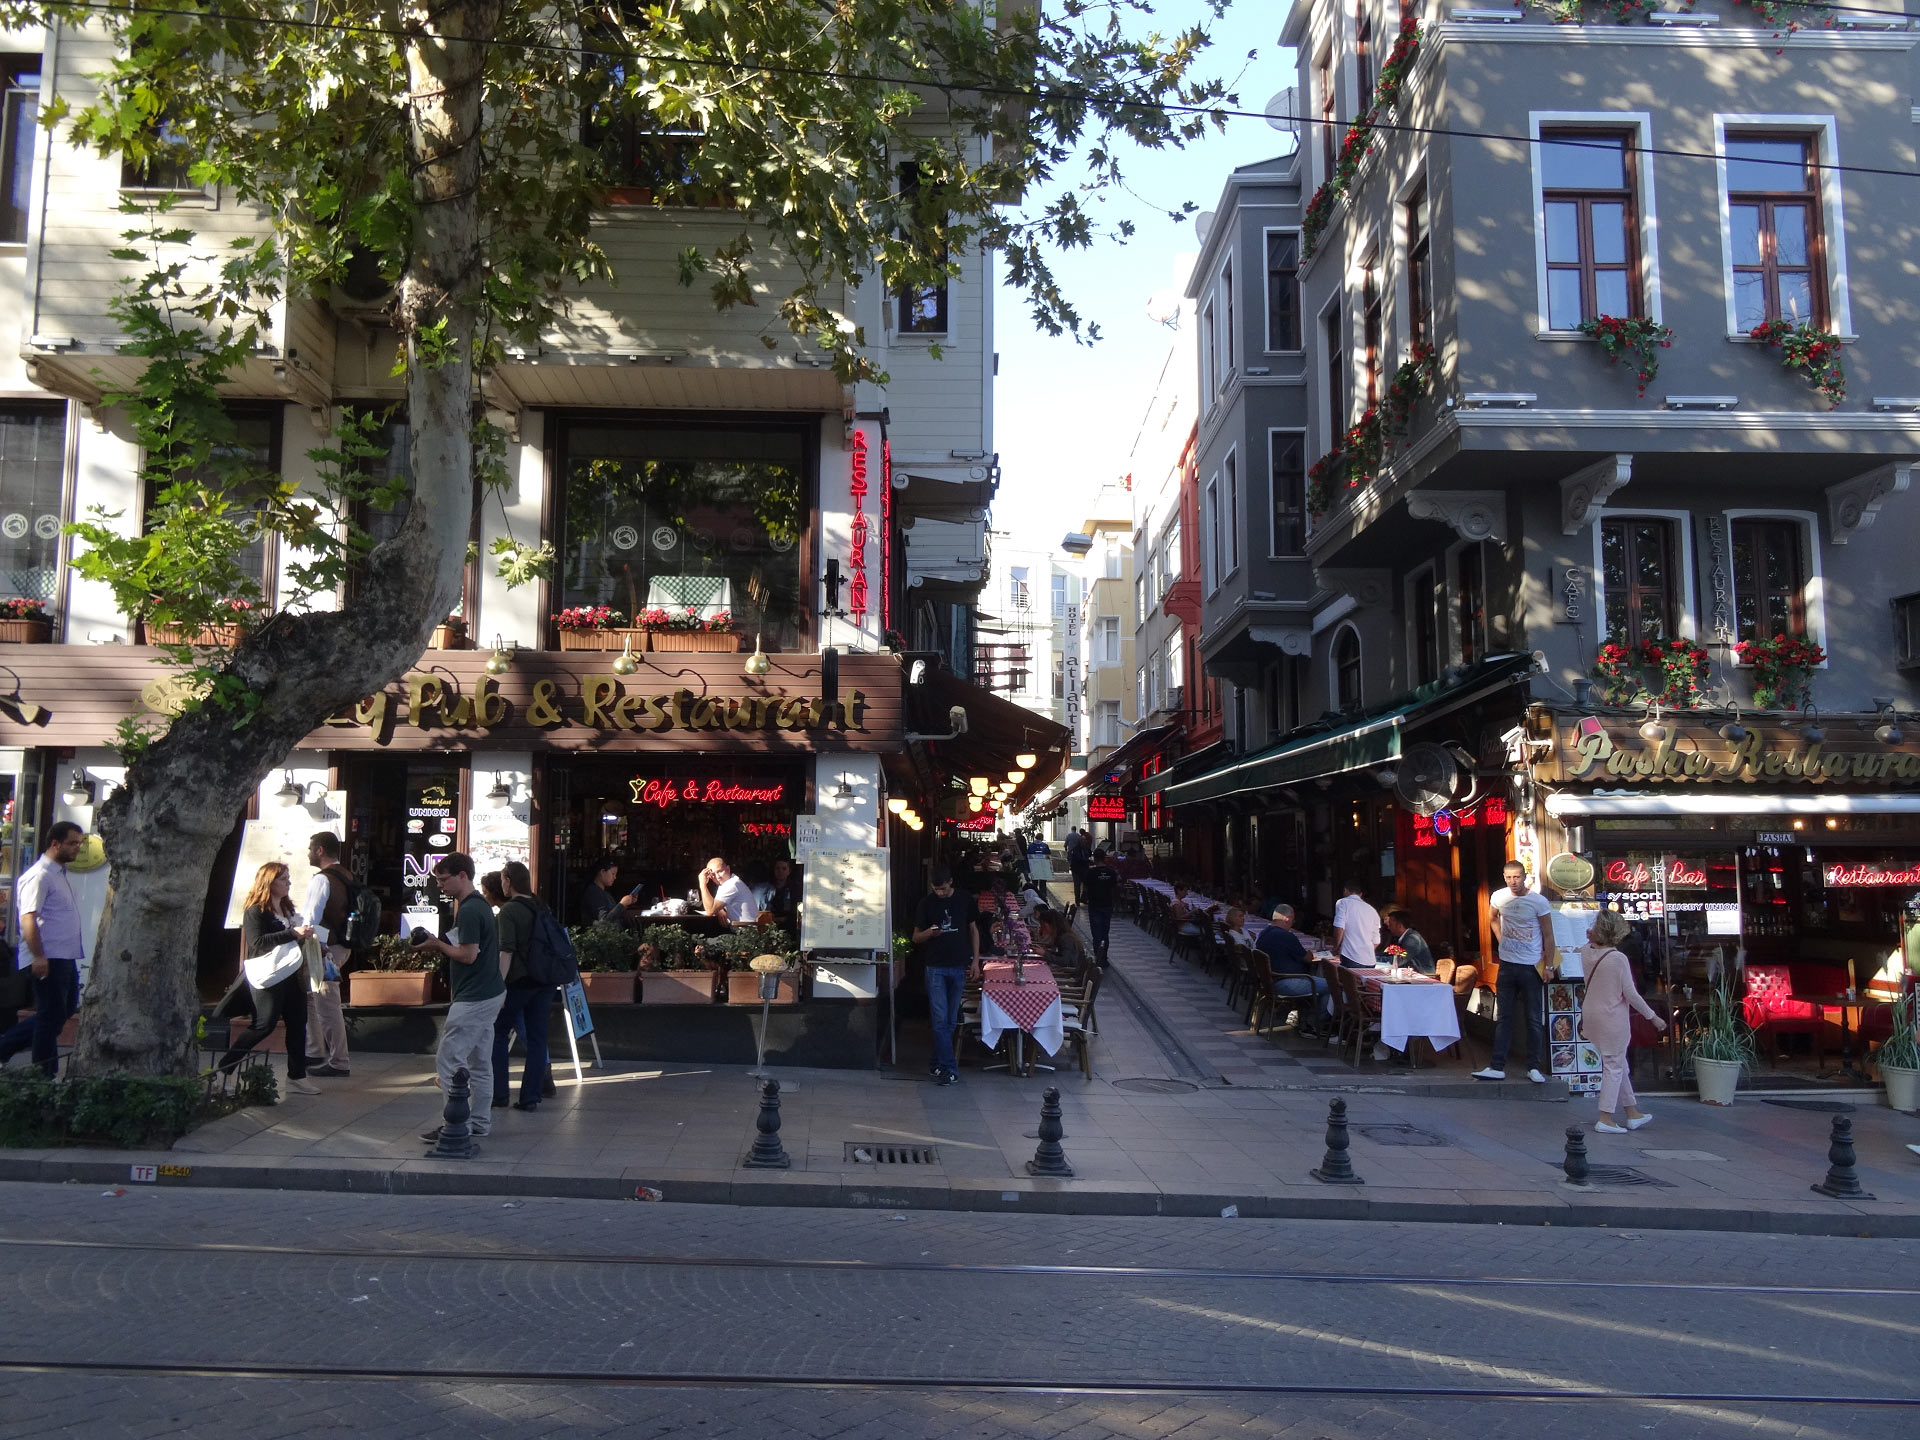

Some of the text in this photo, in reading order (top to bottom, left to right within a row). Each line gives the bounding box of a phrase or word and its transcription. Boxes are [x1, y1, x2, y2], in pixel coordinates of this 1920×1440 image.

[850, 429, 868, 627] RESTAURANT
[1706, 516, 1729, 642] RESTAURANT
[1564, 568, 1580, 619] CAFE
[1068, 607, 1077, 636] HOTEL
[408, 674, 506, 727] Pub
[526, 679, 562, 726] &
[583, 674, 862, 730] Restaurant
[1066, 656, 1079, 748] atlantis
[1566, 726, 1716, 777] Pasha
[420, 797, 452, 807] Breakfast
[644, 779, 783, 807] Cafe & Restaurant
[1091, 797, 1124, 807] ARAS
[408, 808, 450, 817] UNION
[1759, 832, 1791, 843] PASHA
[1607, 860, 1650, 892] Cafe
[1668, 861, 1707, 886] Bar
[1826, 864, 1920, 885] Restaurant
[1666, 903, 1739, 912] RUGBY UNION
[136, 1167, 153, 1180] TF
